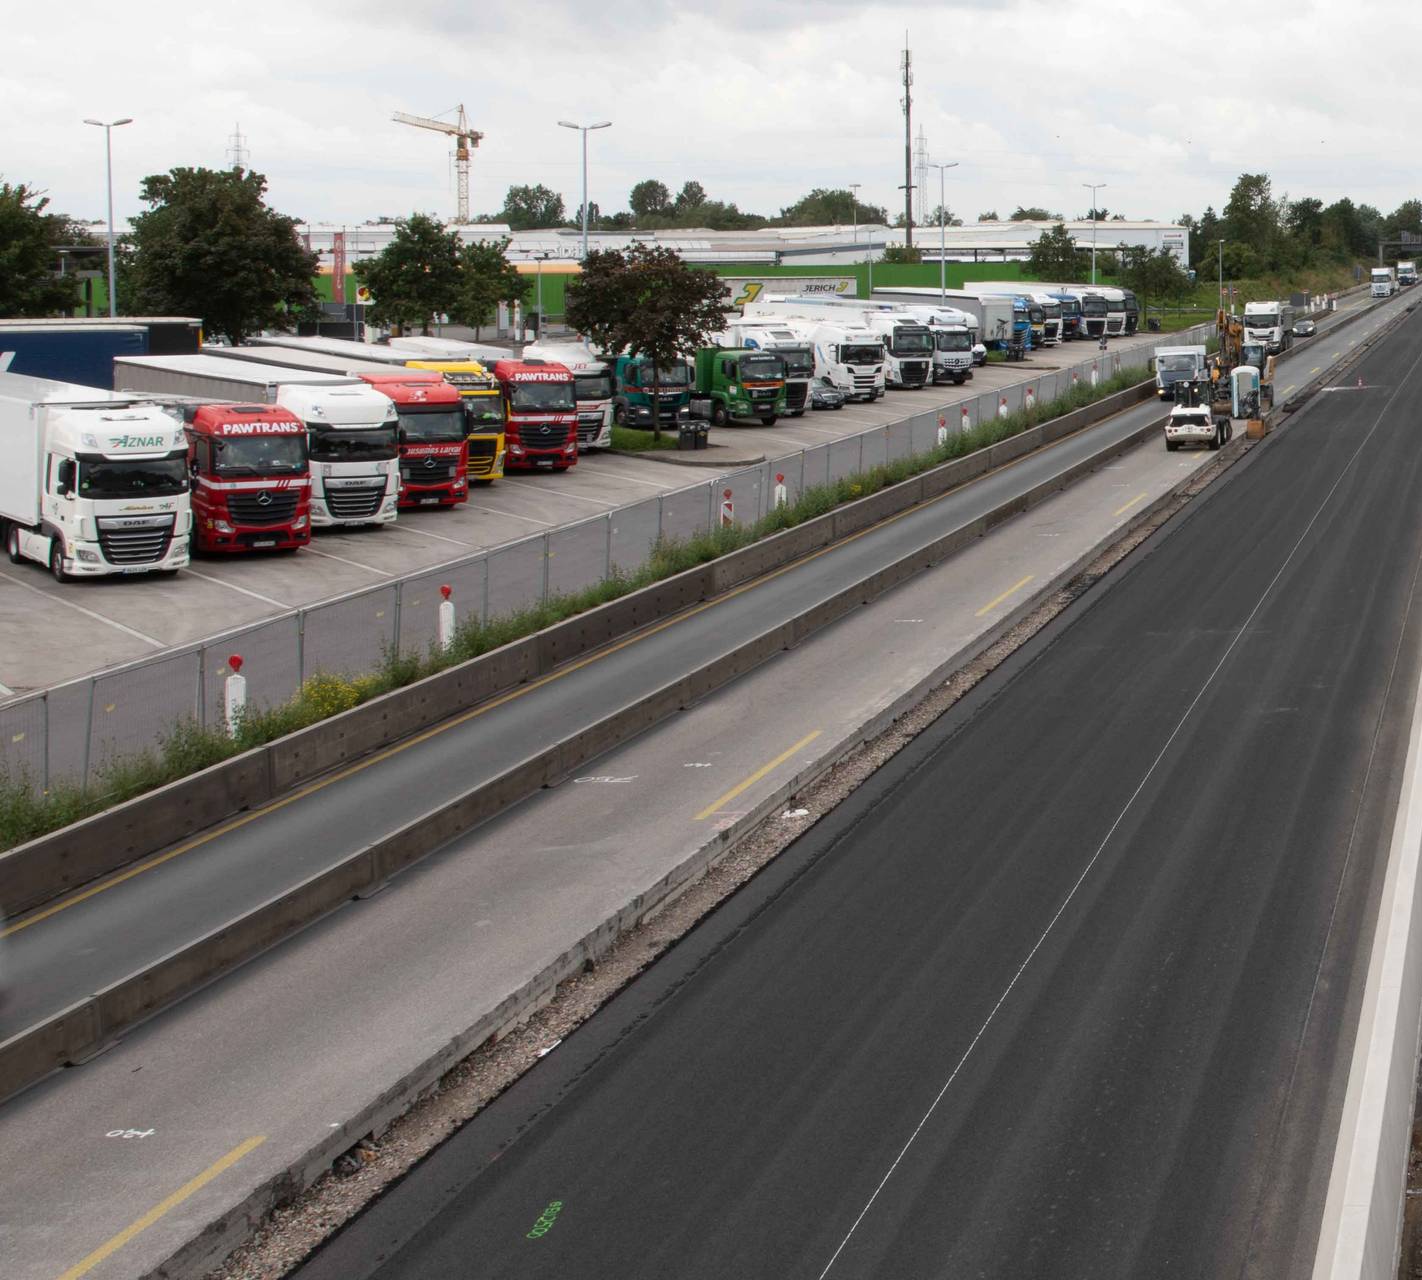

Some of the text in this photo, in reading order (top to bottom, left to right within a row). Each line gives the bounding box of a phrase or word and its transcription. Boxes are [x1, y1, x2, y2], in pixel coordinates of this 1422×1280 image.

[514, 373, 569, 382] PAWTRANS
[222, 422, 299, 435] PAWTRANS
[109, 435, 164, 448] AZNAR
